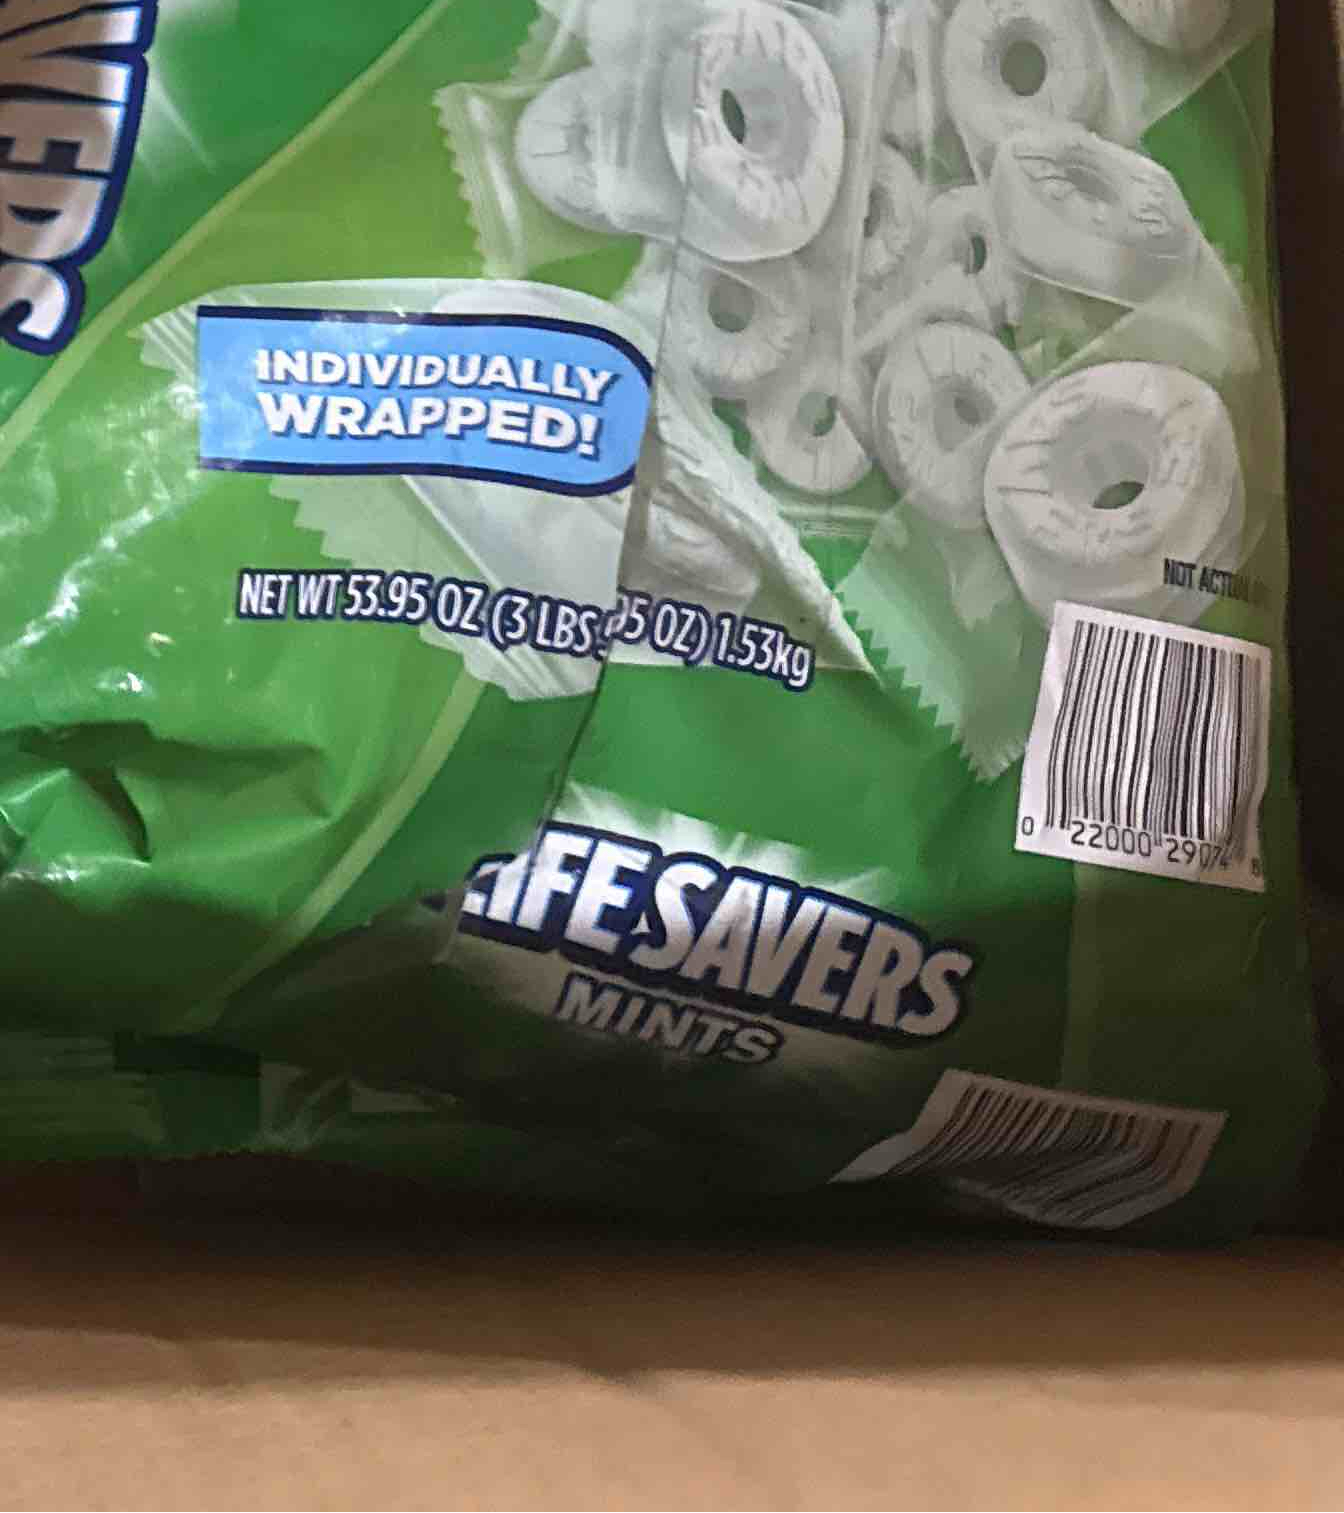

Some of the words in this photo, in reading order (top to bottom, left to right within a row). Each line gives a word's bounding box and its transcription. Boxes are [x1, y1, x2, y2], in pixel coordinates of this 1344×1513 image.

[255, 349, 612, 403] INDIVIDUALLY
[256, 391, 603, 459] WRAPPED!
[1163, 557, 1198, 589] NOT
[239, 573, 287, 619] NET
[296, 574, 342, 619] WT
[346, 574, 428, 622] 53.95
[436, 583, 483, 635] OZ
[490, 592, 528, 648] (3
[537, 600, 595, 655] LBS
[653, 602, 710, 662] OZ)
[714, 617, 811, 688] 1.53kg
[1021, 815, 1035, 837] 0
[1070, 819, 1153, 858] 22000
[554, 971, 781, 1065] MINTS
